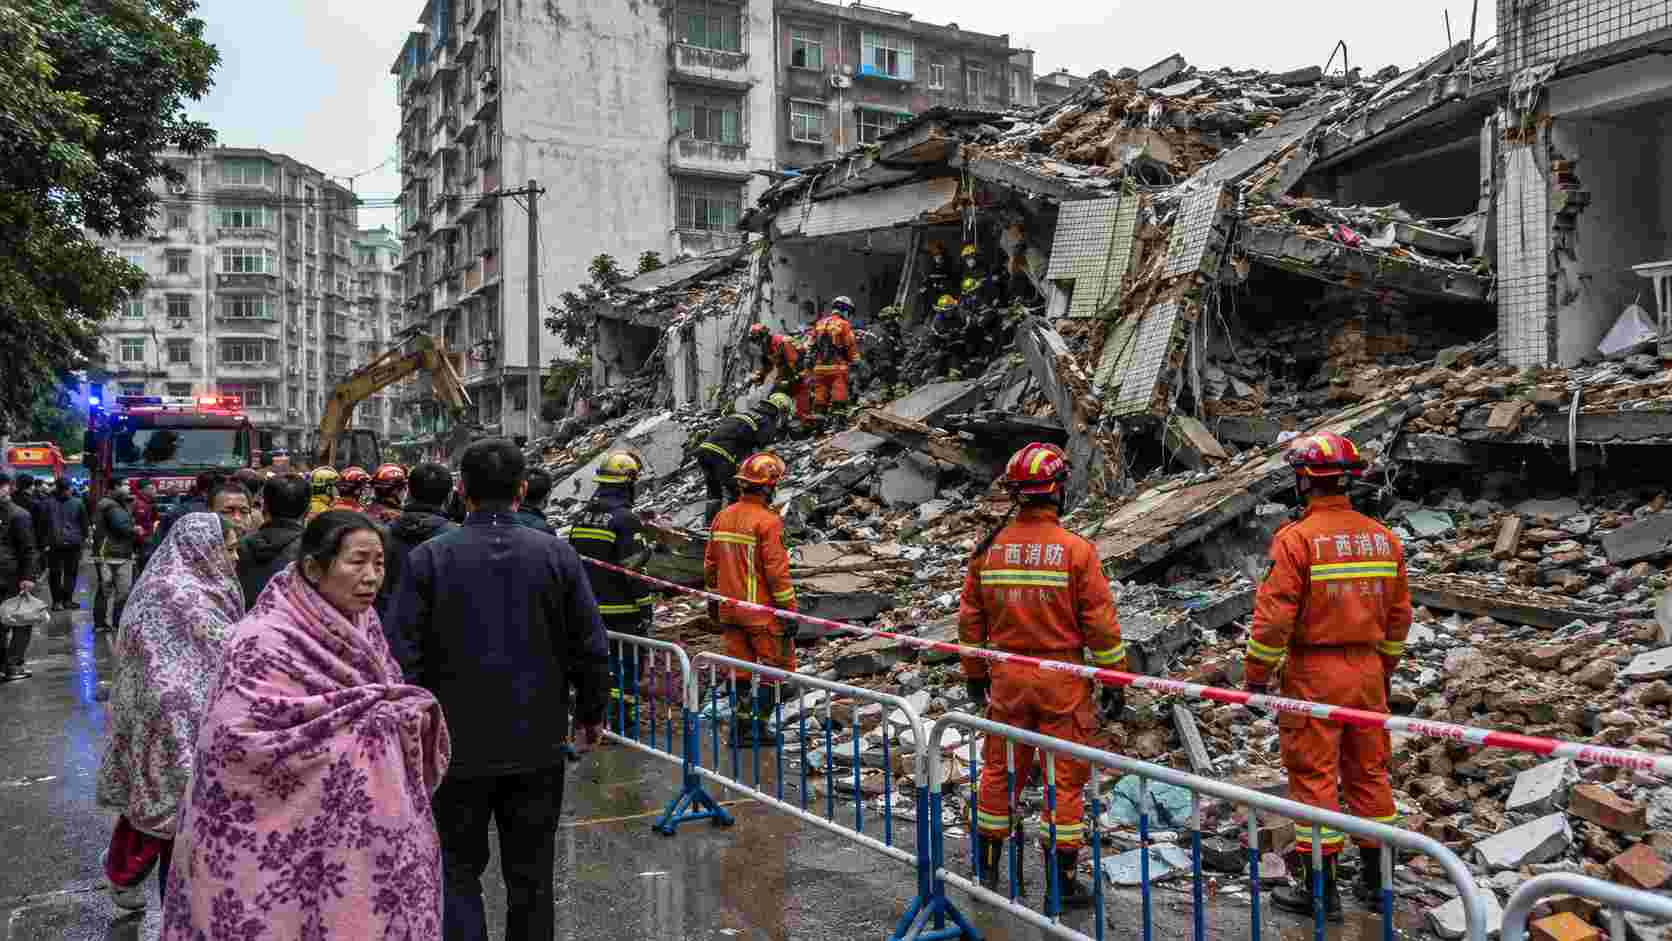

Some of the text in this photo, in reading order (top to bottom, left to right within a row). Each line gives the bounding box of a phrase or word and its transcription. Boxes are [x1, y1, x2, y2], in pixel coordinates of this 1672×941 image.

[984, 543, 1065, 566] 广西消防
[1312, 532, 1392, 560] 广西消防
